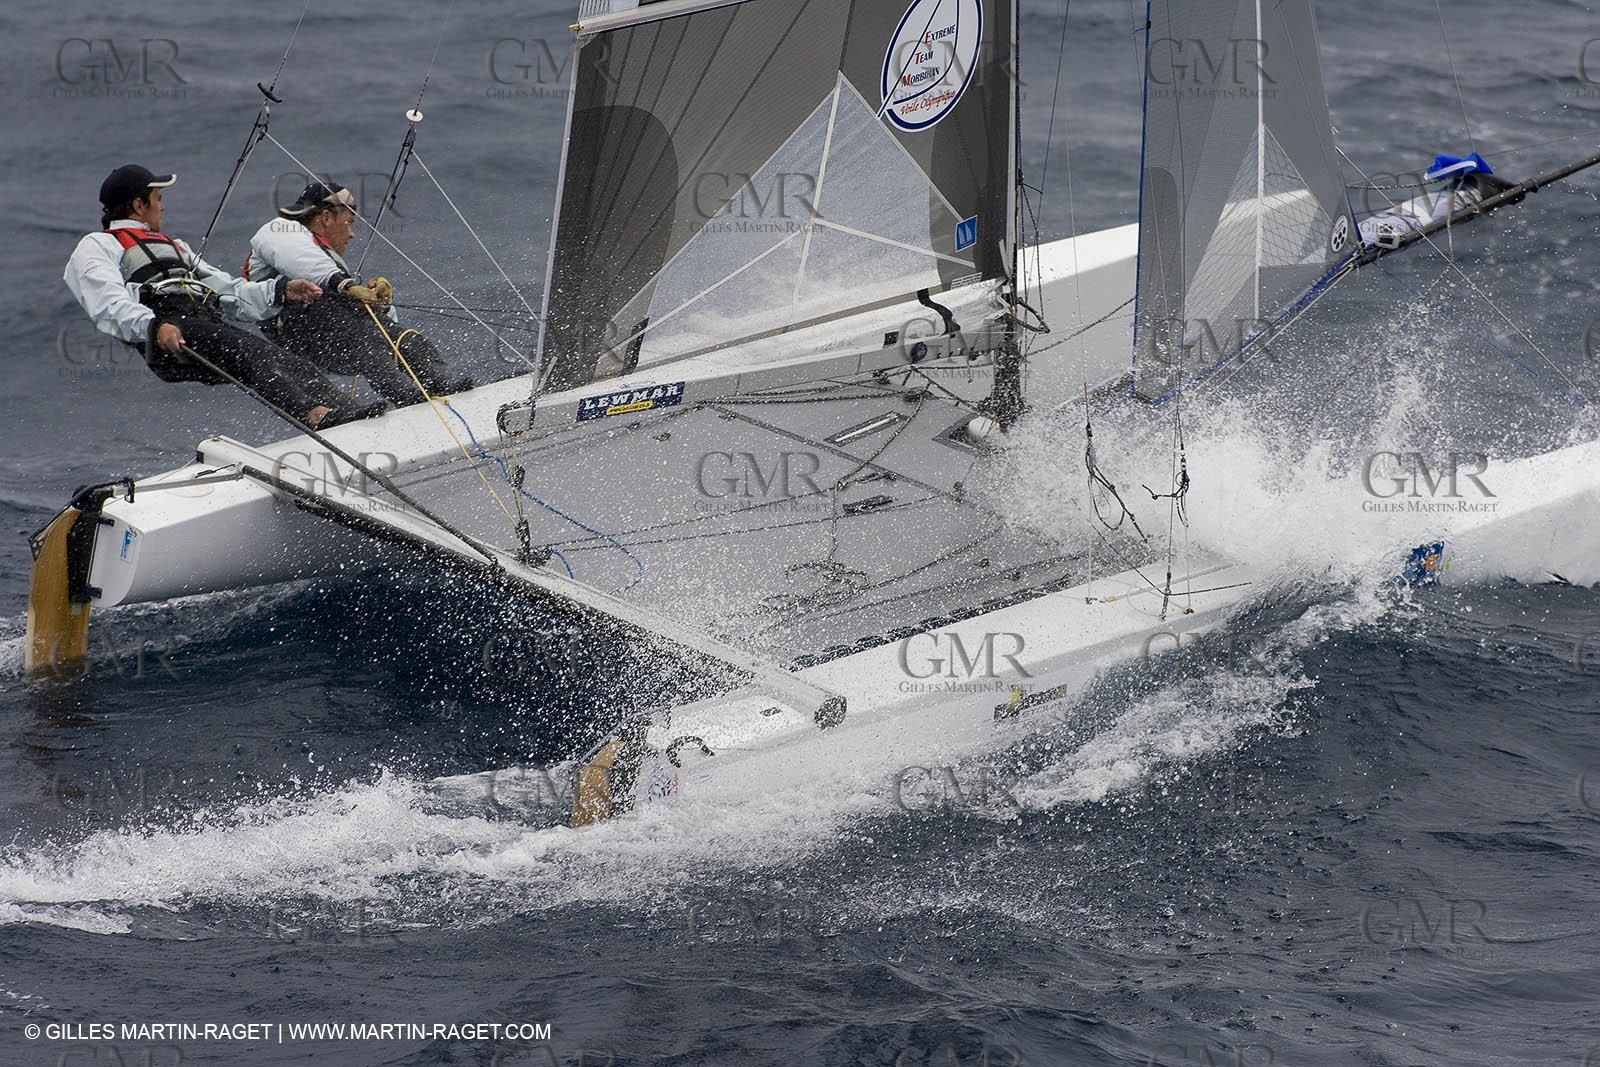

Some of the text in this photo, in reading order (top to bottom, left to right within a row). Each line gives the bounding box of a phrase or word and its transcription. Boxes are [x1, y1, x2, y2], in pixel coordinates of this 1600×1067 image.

[925, 24, 956, 44] EXTREME
[915, 51, 933, 64] TEAM
[583, 385, 680, 410] LEWMAR
